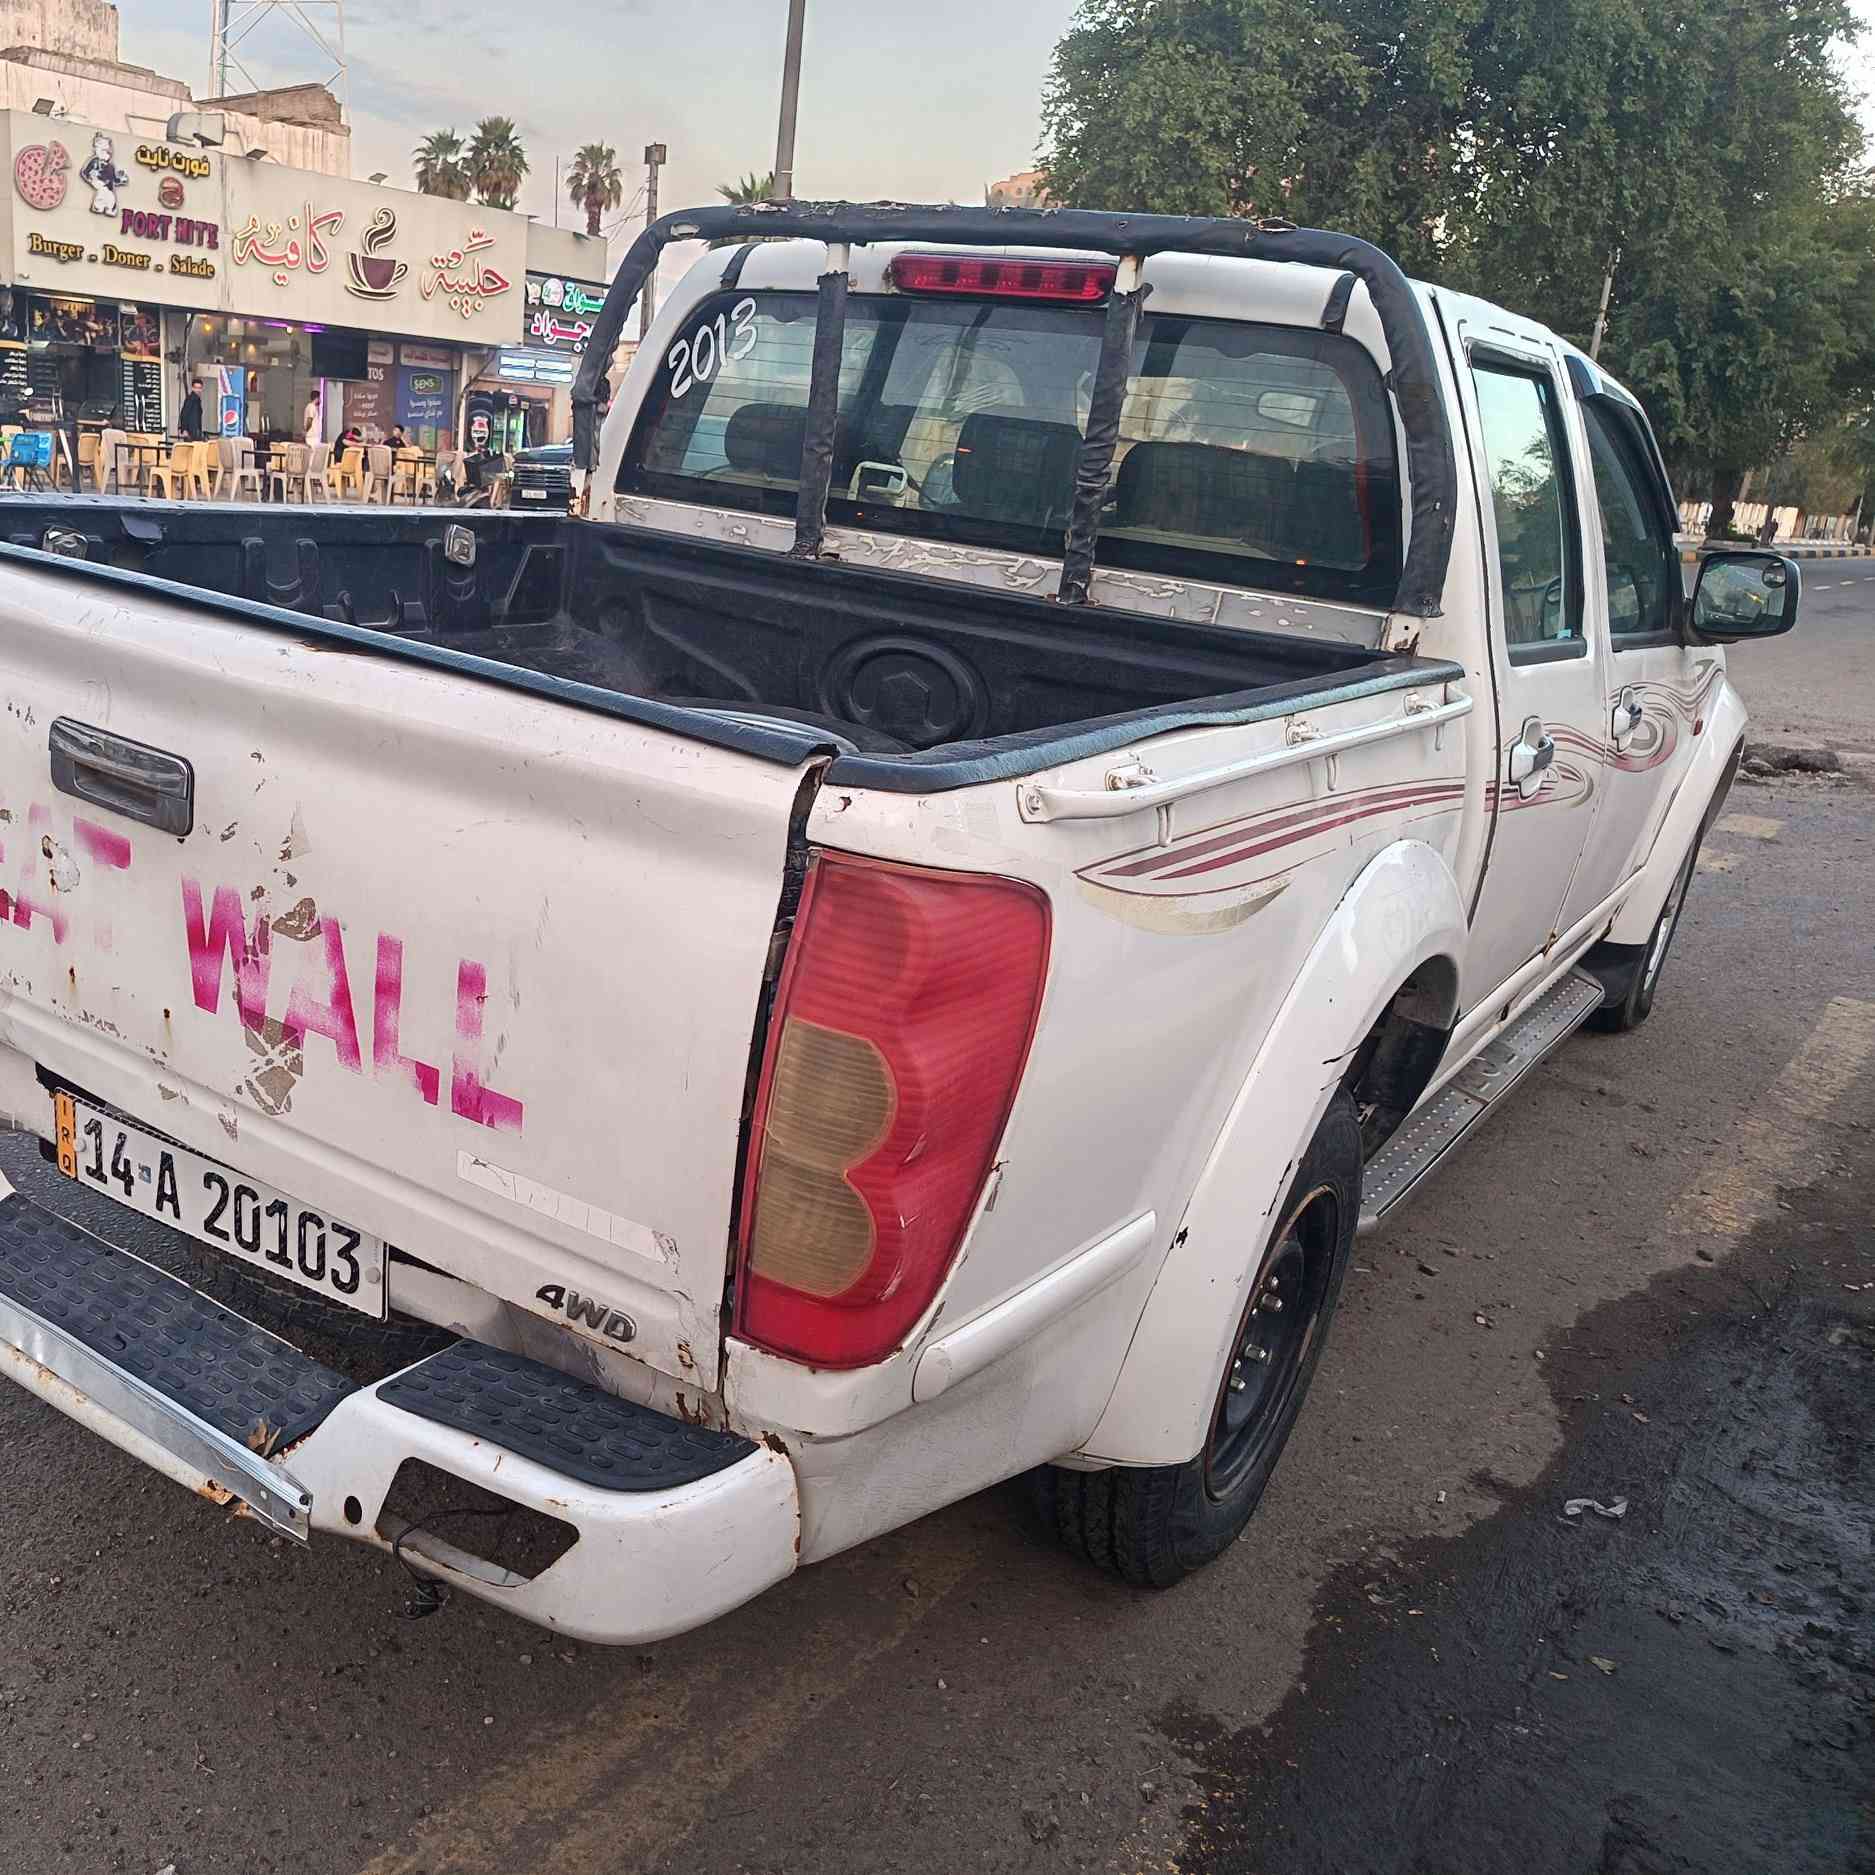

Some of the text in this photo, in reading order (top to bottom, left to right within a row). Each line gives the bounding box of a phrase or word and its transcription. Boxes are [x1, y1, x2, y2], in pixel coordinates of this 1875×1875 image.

[135, 144, 210, 180] فورت نايت
[29, 232, 215, 279] Burger Doner Salade
[121, 208, 219, 249] FORT NITE
[668, 297, 757, 398] 2013
[181, 868, 524, 1132] WALL
[203, 1171, 360, 1294] 20103
[536, 1284, 638, 1342] 4WD
